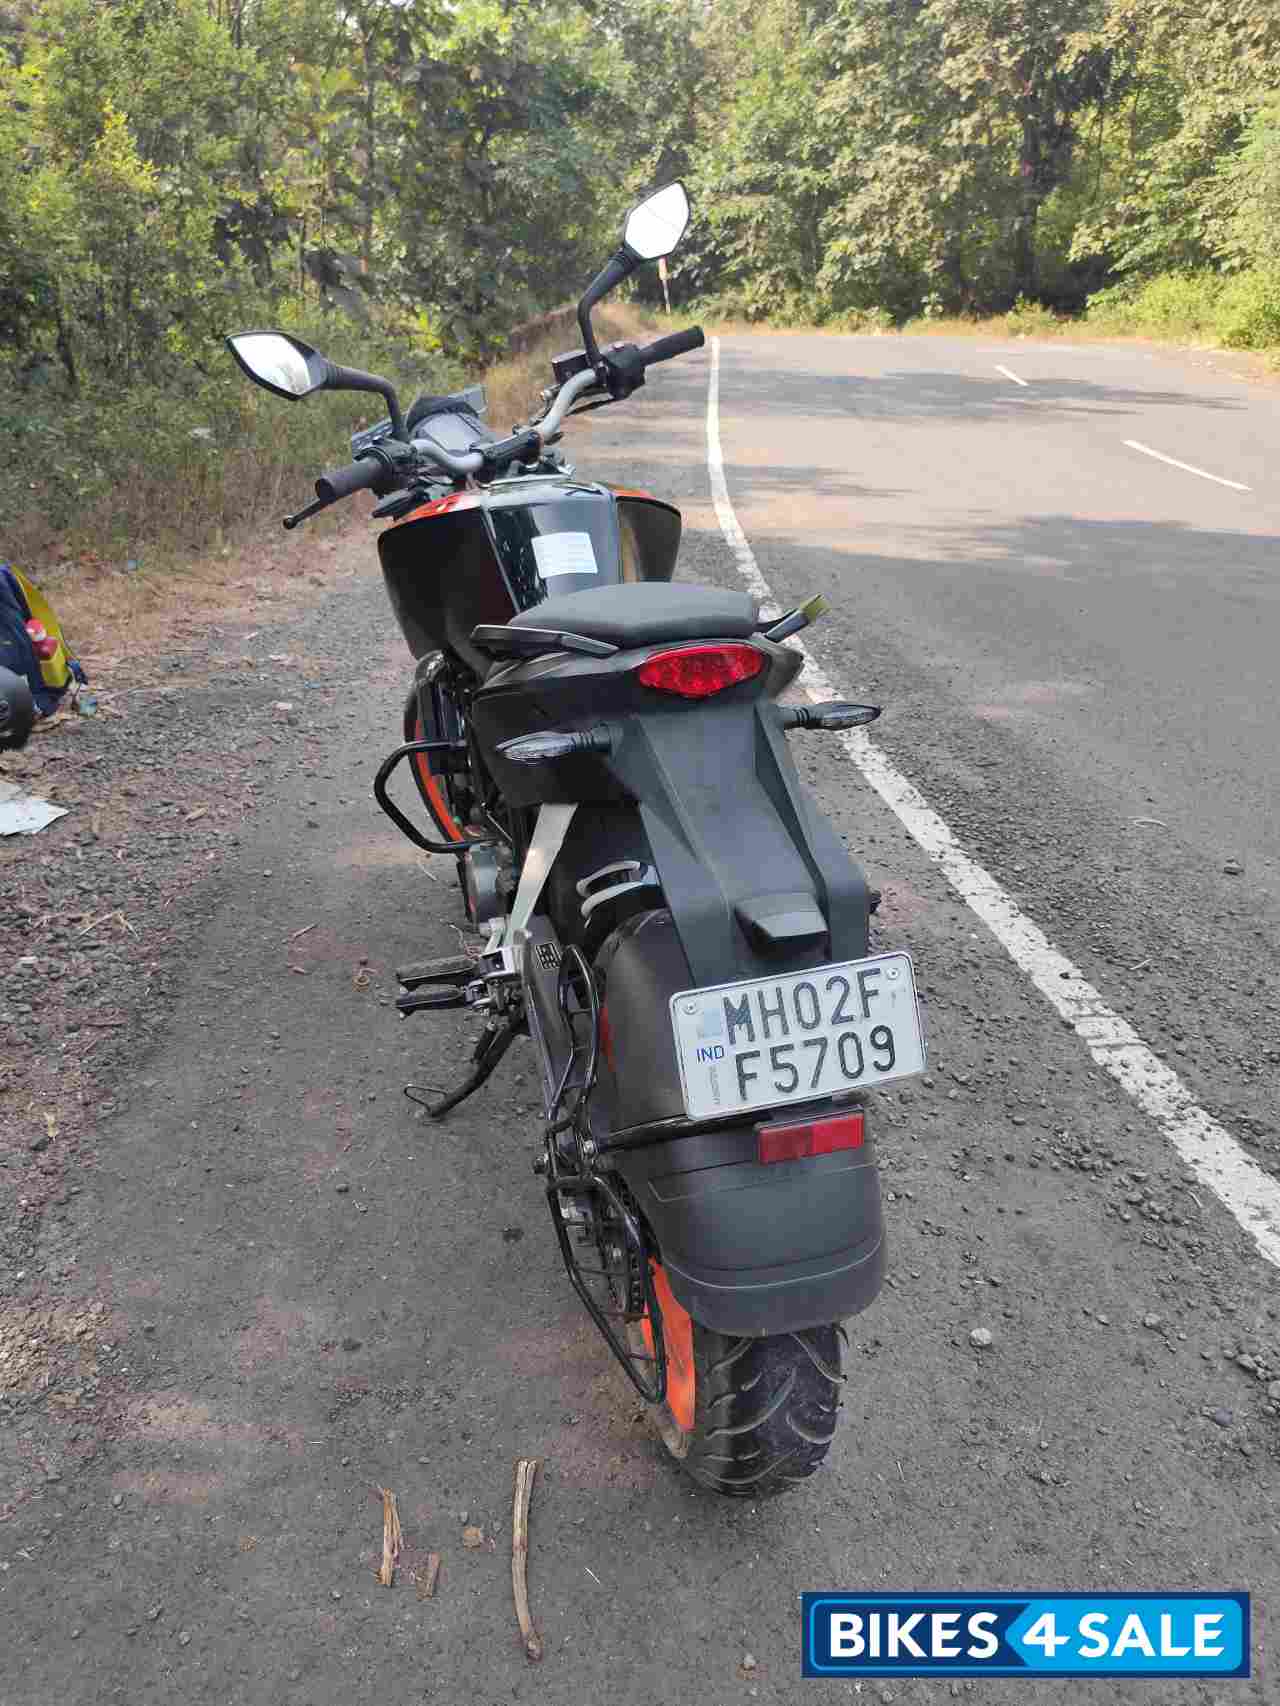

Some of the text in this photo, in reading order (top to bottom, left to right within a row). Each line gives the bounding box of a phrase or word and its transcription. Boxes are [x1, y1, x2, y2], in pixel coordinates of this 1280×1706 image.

[723, 968, 881, 1045] MH02F
[696, 1045, 725, 1064] IND
[735, 1025, 896, 1101] F5709
